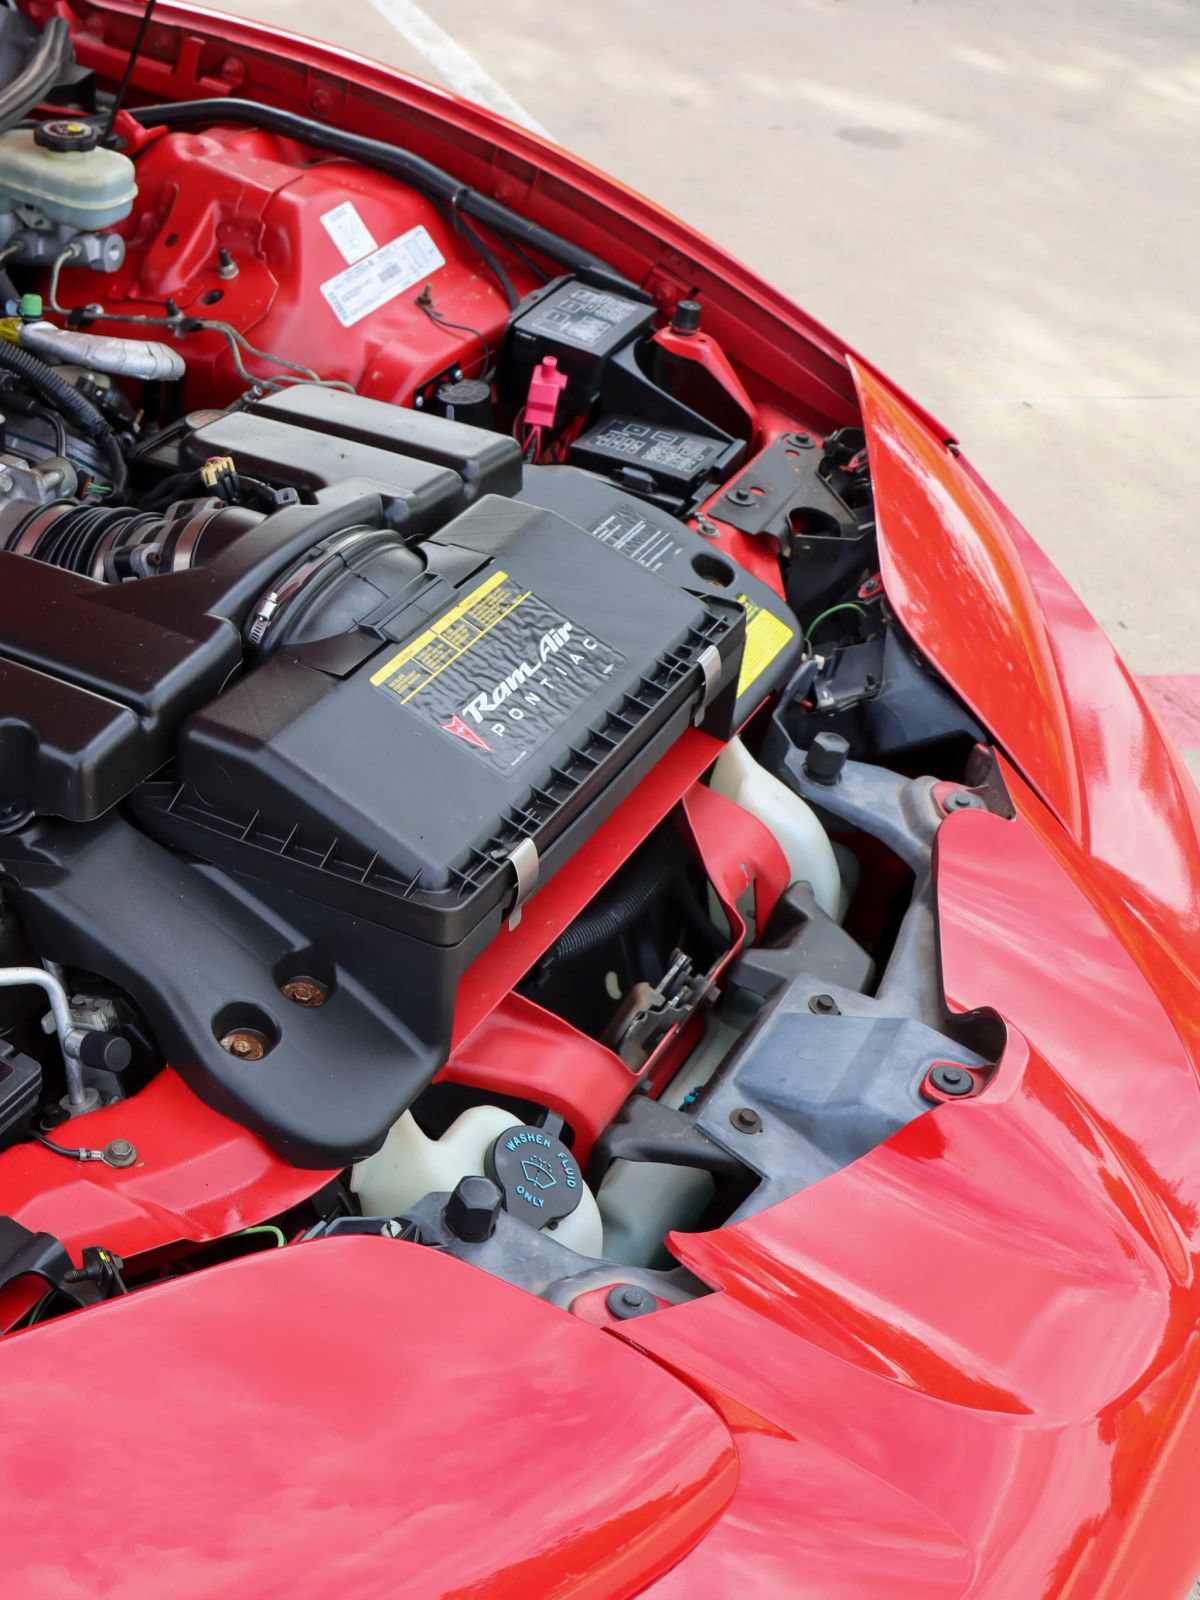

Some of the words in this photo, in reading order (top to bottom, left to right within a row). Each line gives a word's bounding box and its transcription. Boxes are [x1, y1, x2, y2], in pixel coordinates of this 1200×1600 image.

[462, 661, 542, 724] Ram
[539, 621, 573, 663] Air
[491, 638, 598, 737] PONTIAC
[505, 1132, 551, 1152] WASHER
[556, 1151, 576, 1188] FLUID
[515, 1185, 545, 1208] ONLY
